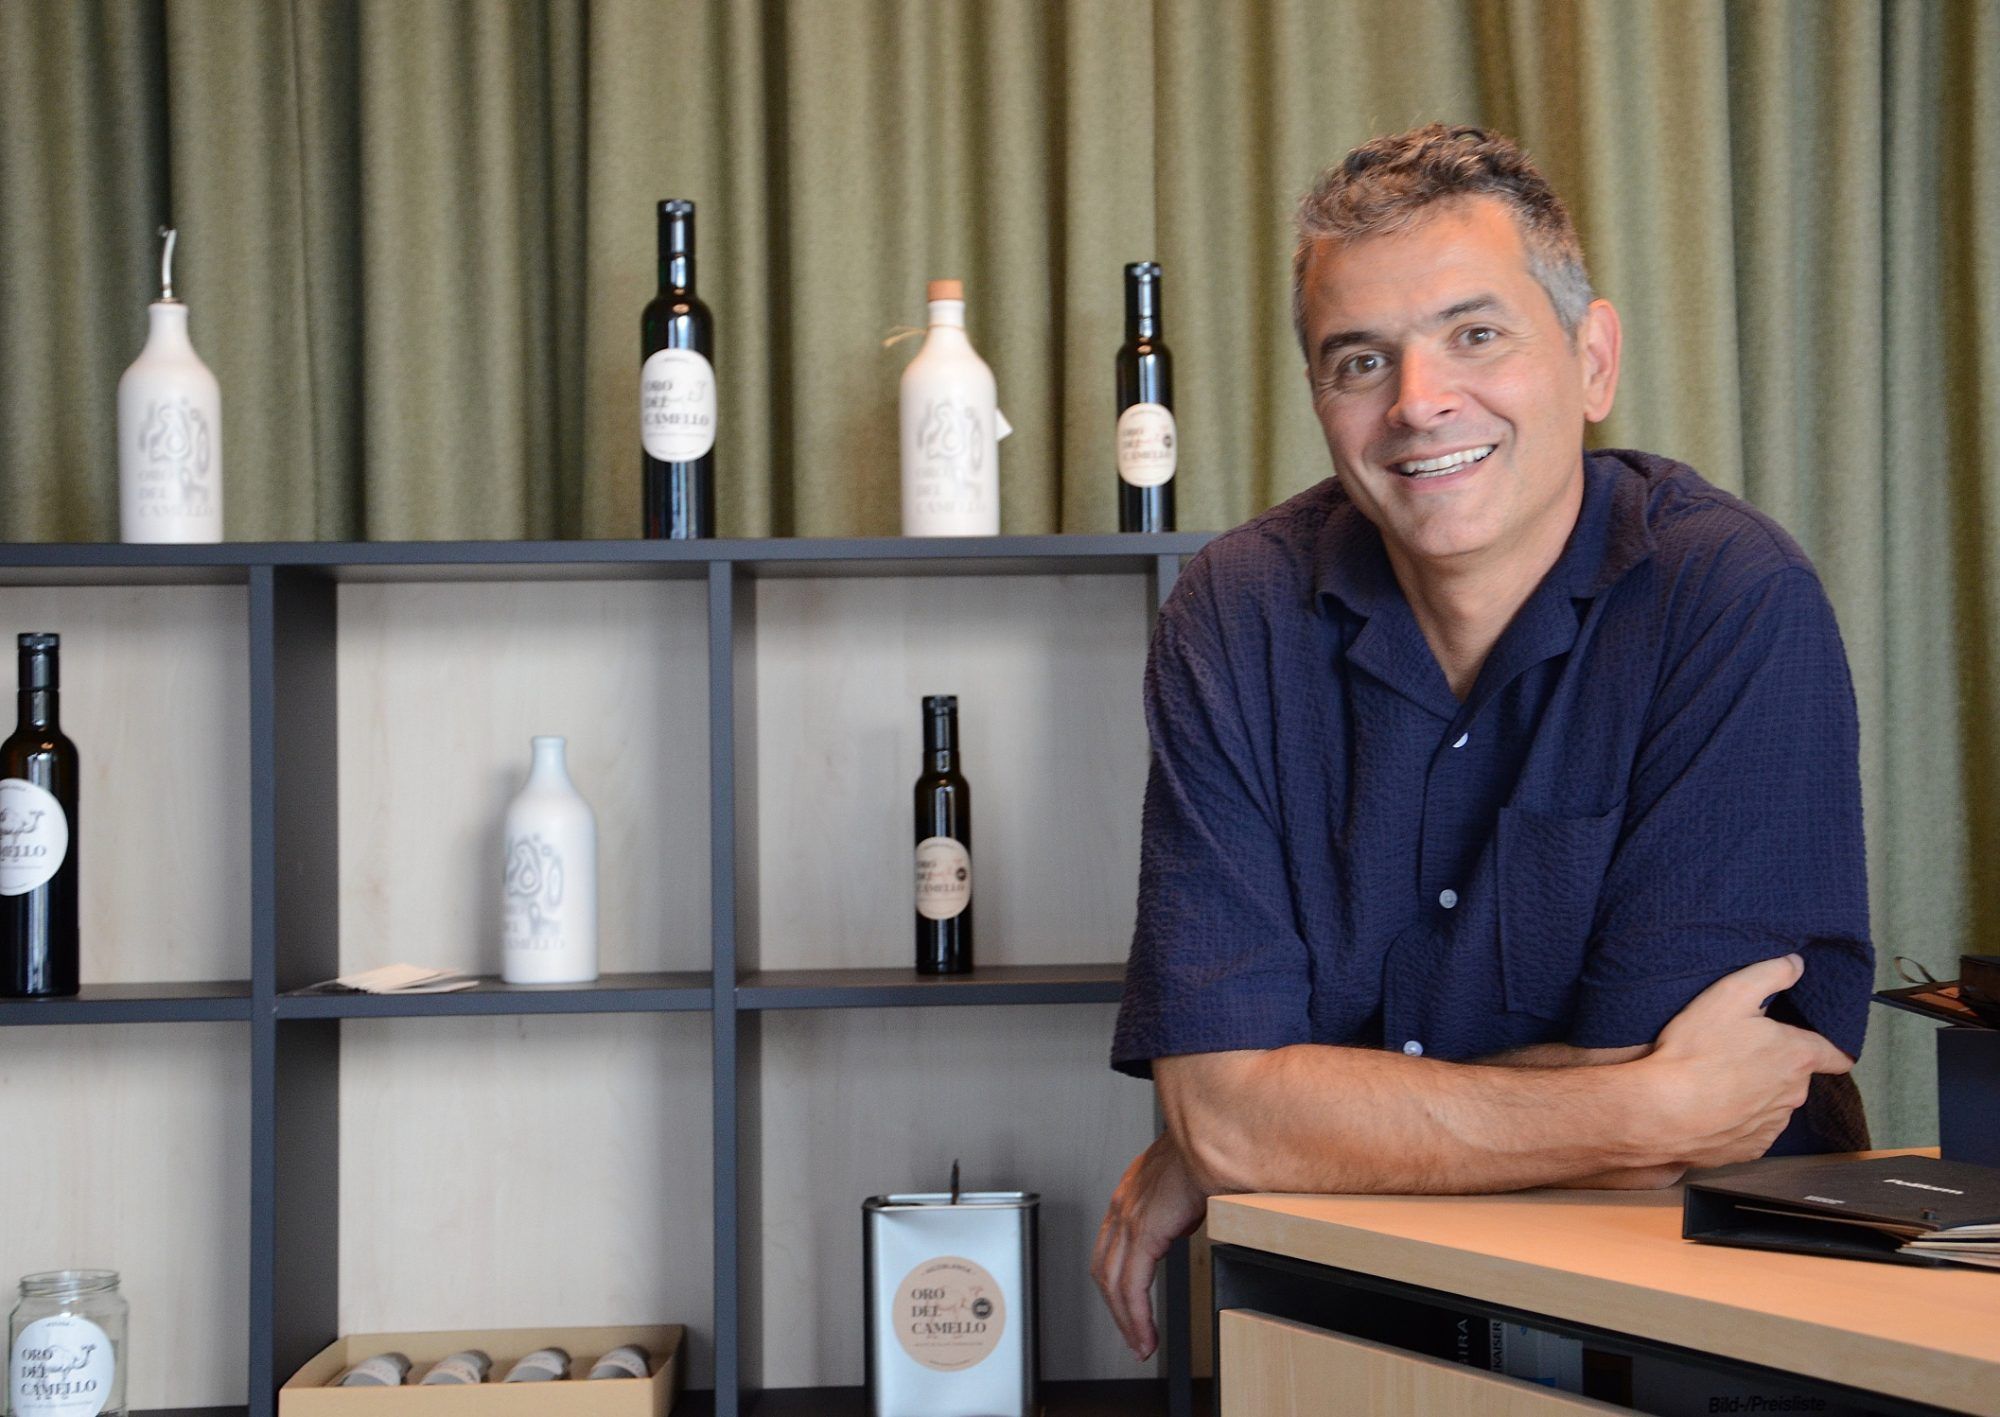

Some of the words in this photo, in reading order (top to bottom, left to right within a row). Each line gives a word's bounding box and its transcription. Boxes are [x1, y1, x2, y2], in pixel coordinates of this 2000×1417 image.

[645, 413, 710, 425] CAMELLO
[911, 1287, 945, 1300] ORO
[911, 1305, 941, 1318] DEL
[911, 1321, 986, 1335] CAMELLO
[1492, 1320, 1505, 1371] KAISER
[21, 1348, 53, 1361] ORO
[21, 1366, 48, 1379] DEL
[21, 1380, 97, 1396] CAMELLO
[1708, 1395, 1826, 1414] Bild-/Preisliste
